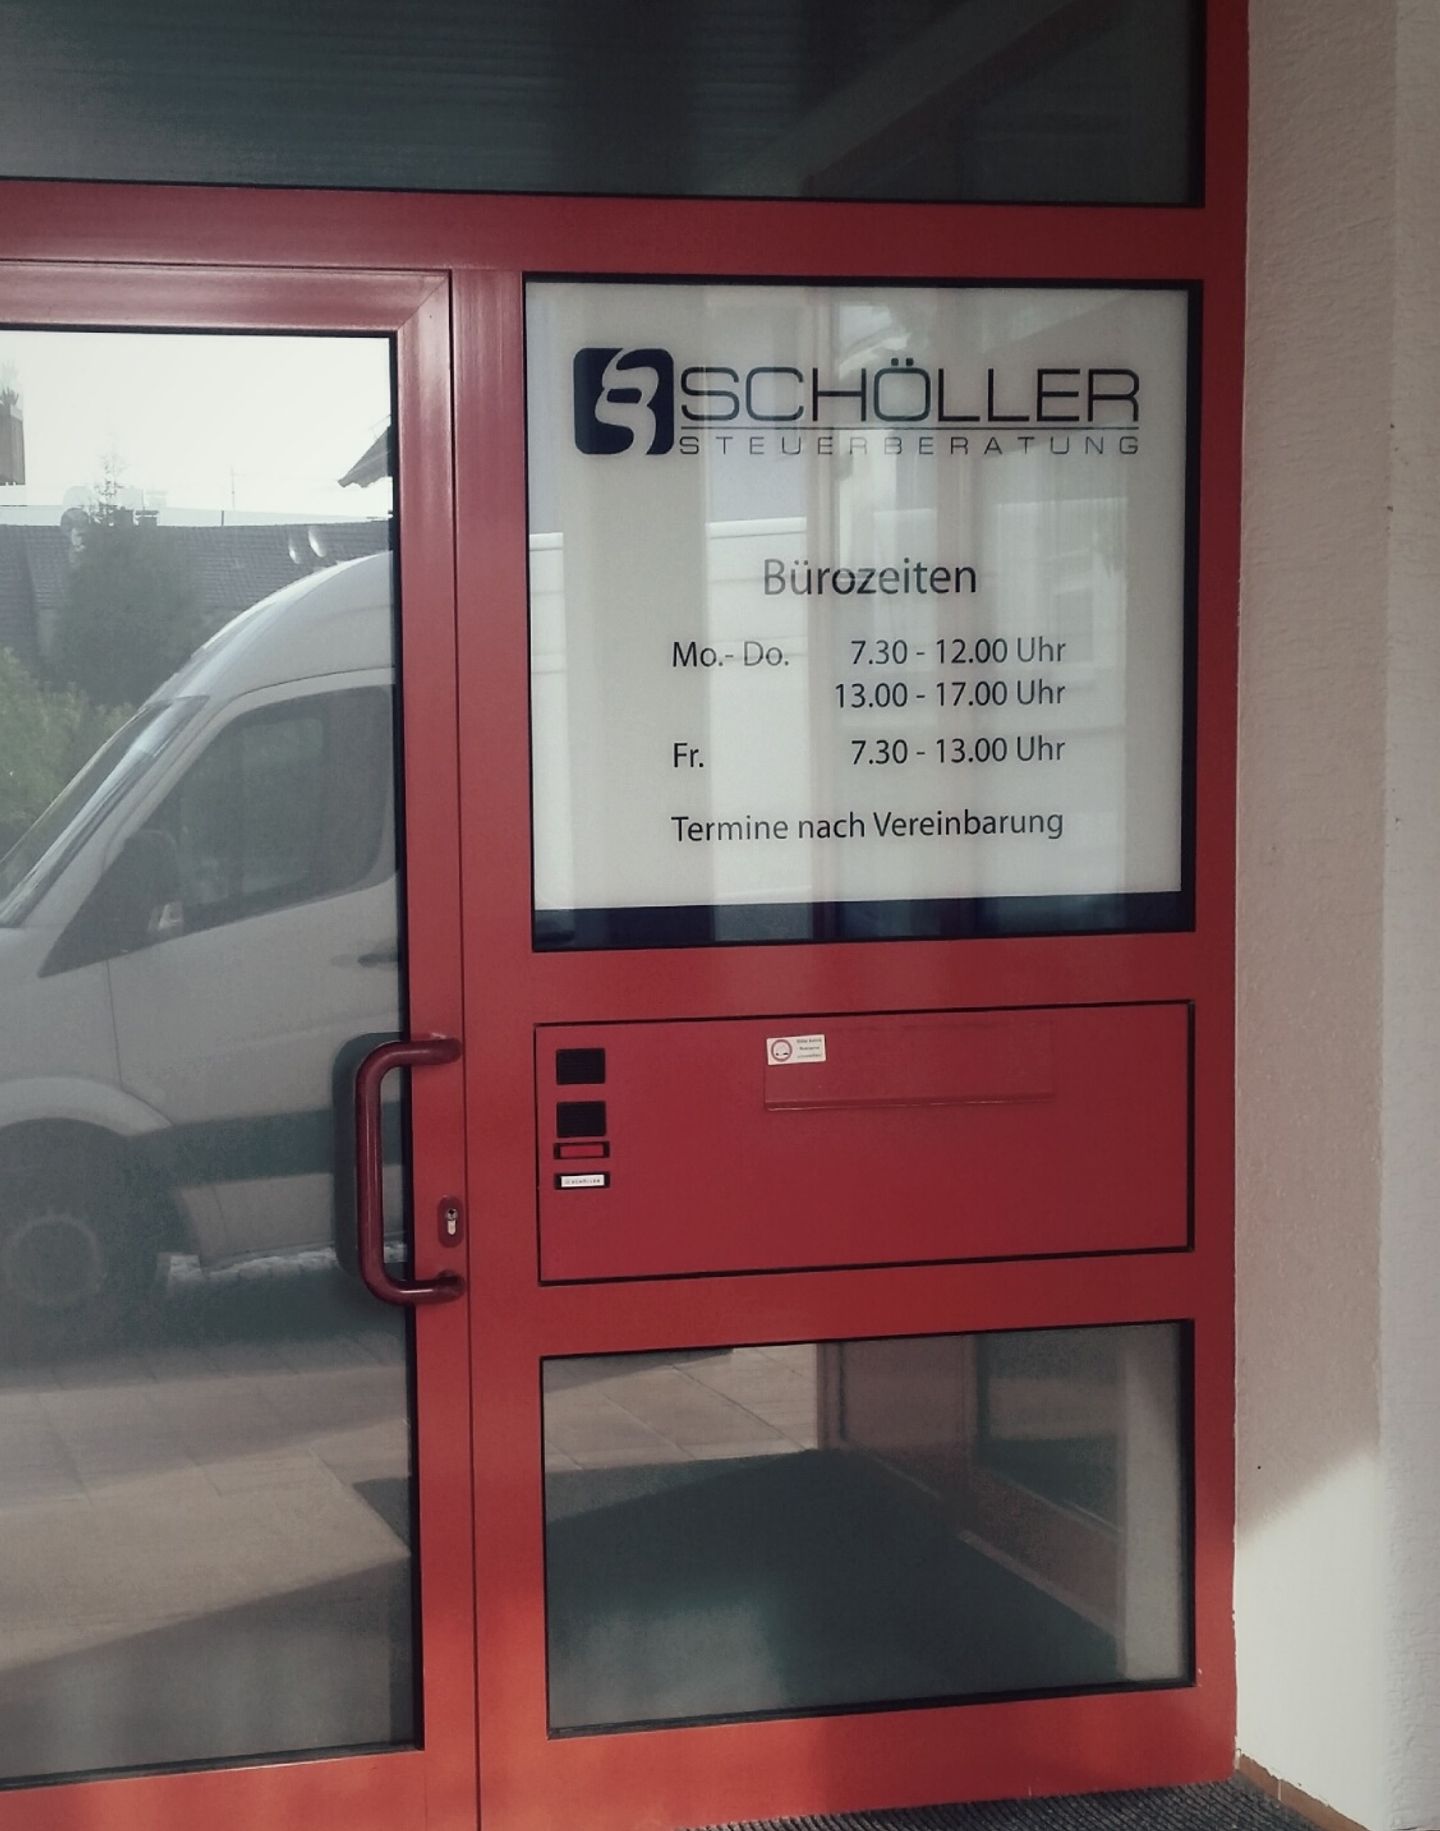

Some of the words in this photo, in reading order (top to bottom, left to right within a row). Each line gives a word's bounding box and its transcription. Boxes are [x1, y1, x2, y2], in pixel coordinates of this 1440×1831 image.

[680, 357, 1140, 423] SCHÖLLER
[680, 435, 1140, 456] STEUERBERATUNG
[763, 557, 977, 595] Bürozeiten
[743, 640, 790, 666] Do.
[850, 639, 908, 665] 7.30
[936, 638, 1007, 664] 12.00
[1016, 636, 1067, 663] Uhr
[835, 682, 908, 708] 13.00
[936, 680, 1007, 706] 17.00
[1016, 679, 1066, 705] Uhr
[673, 742, 705, 768] Fr.
[851, 739, 908, 765] 7.30
[936, 737, 1007, 763] 13.00
[1016, 735, 1066, 762] Uhr
[671, 815, 789, 842] Termine
[799, 811, 865, 839] nach
[873, 808, 1064, 840] Vereinbarung
